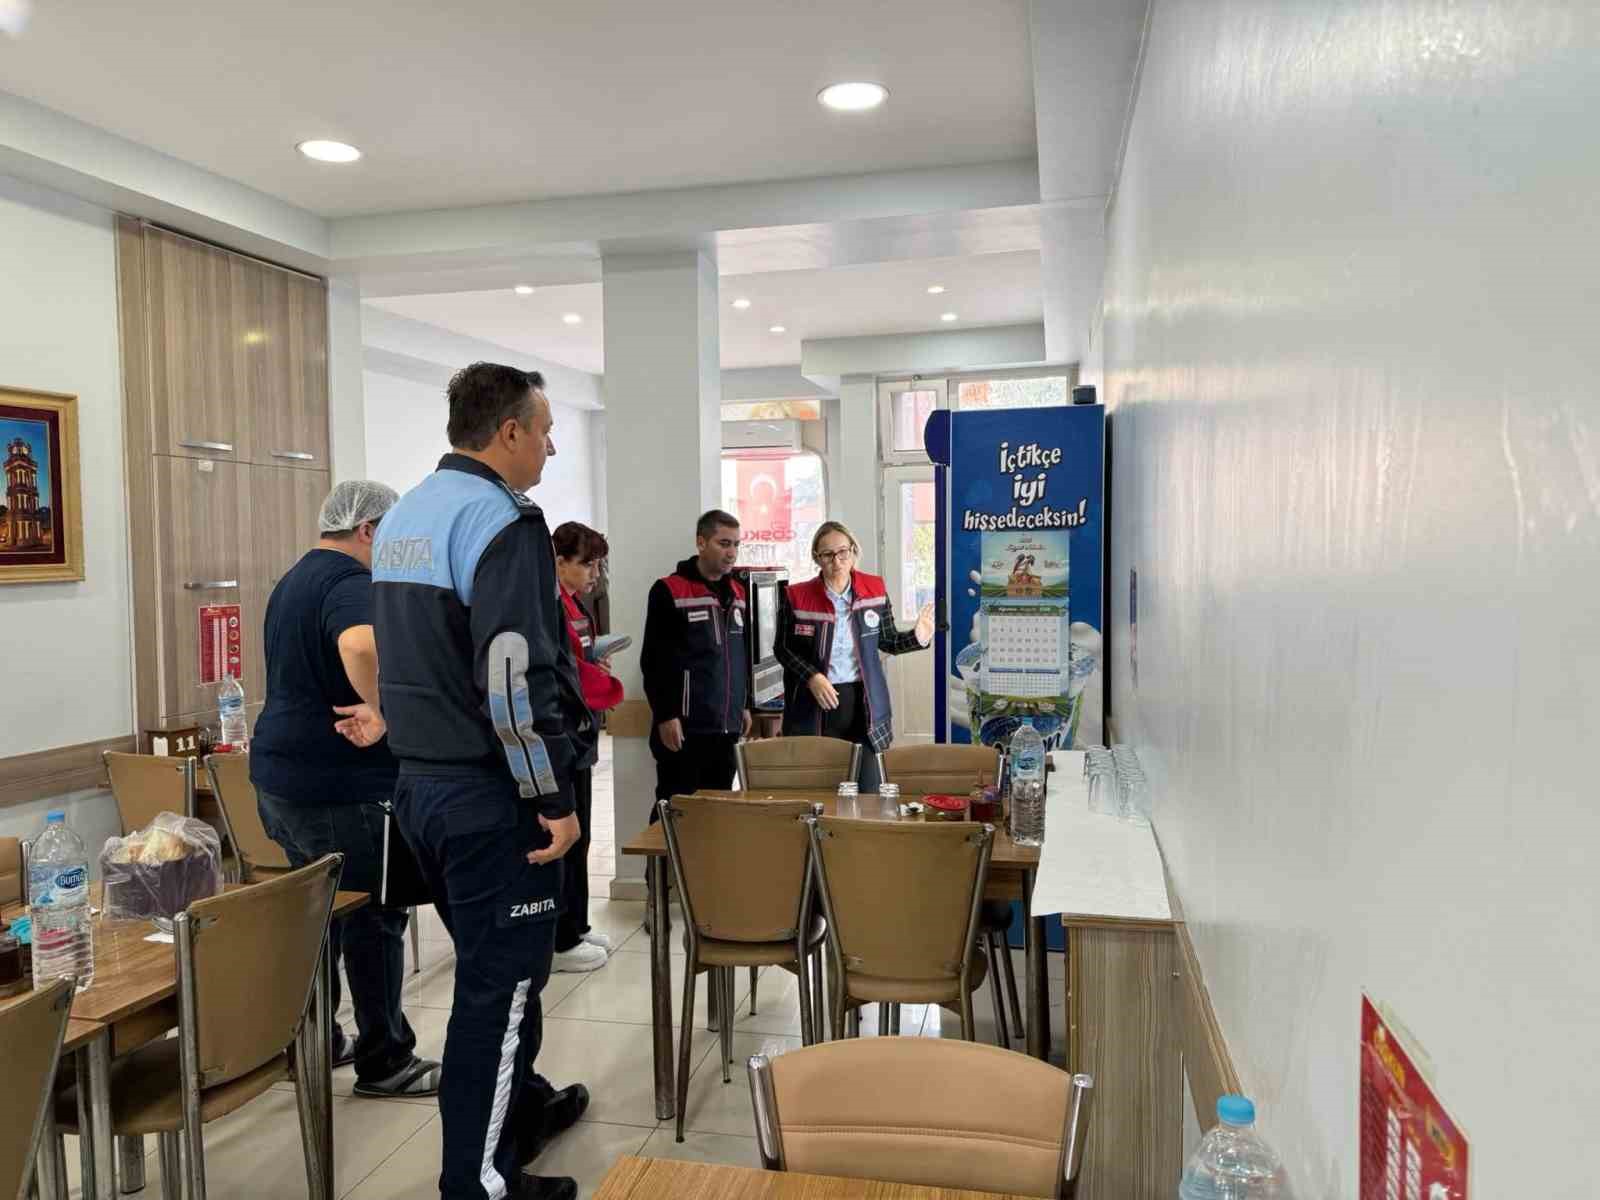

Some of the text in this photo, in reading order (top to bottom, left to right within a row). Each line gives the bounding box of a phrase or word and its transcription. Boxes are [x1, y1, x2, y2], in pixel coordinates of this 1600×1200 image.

[1000, 441, 1062, 473] İçtikçe
[1013, 473, 1047, 507] iyi
[963, 498, 1088, 530] hissedeceksin!
[175, 735, 197, 753] 11
[509, 898, 556, 918] ZABITA
